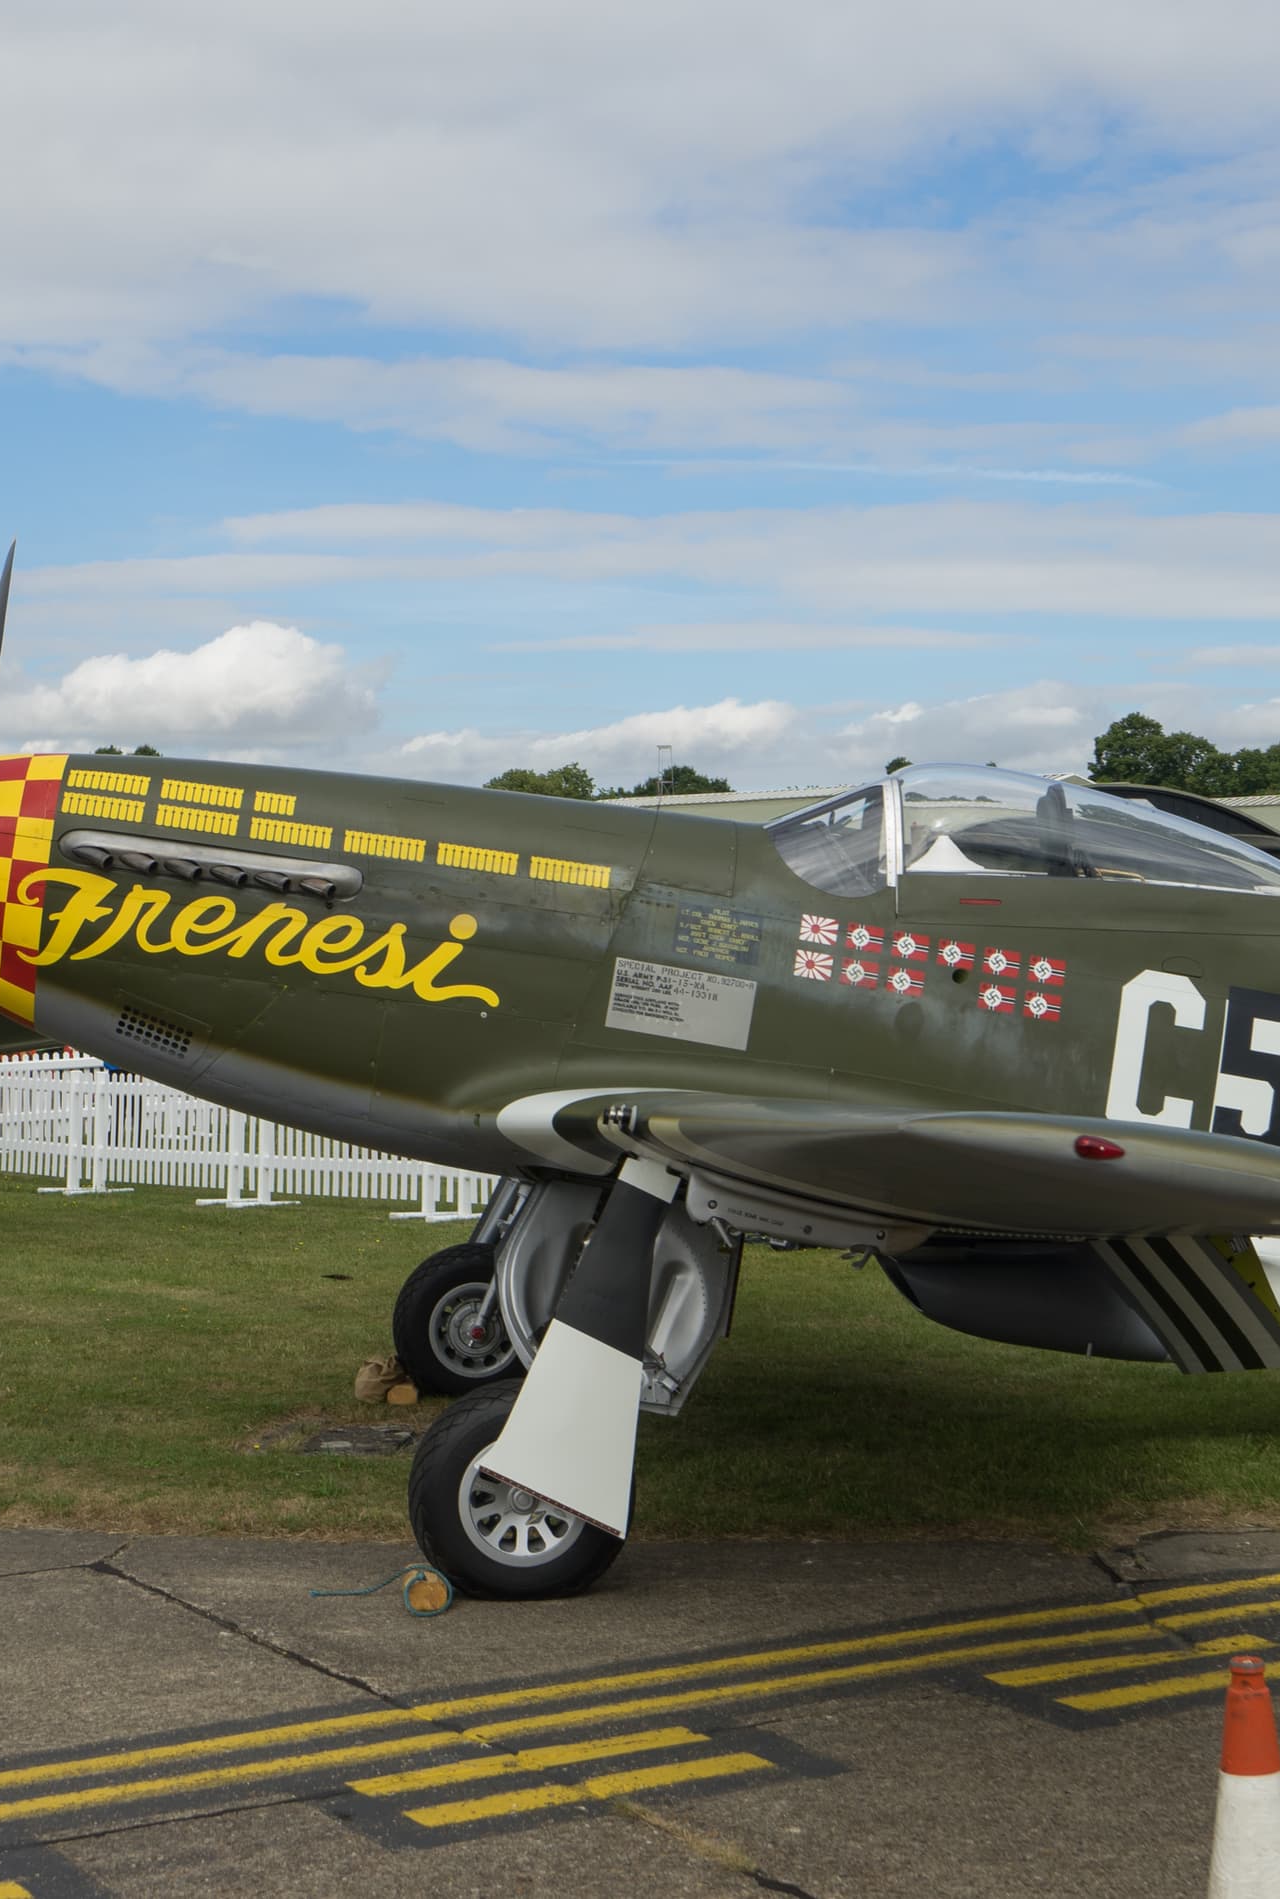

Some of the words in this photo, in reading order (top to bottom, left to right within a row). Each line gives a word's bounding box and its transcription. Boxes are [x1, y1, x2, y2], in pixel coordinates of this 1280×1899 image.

[17, 866, 500, 1008] Frenesi
[618, 959, 656, 974] SPECIAL
[661, 967, 703, 980] PROJECT
[632, 971, 654, 980] ARMY
